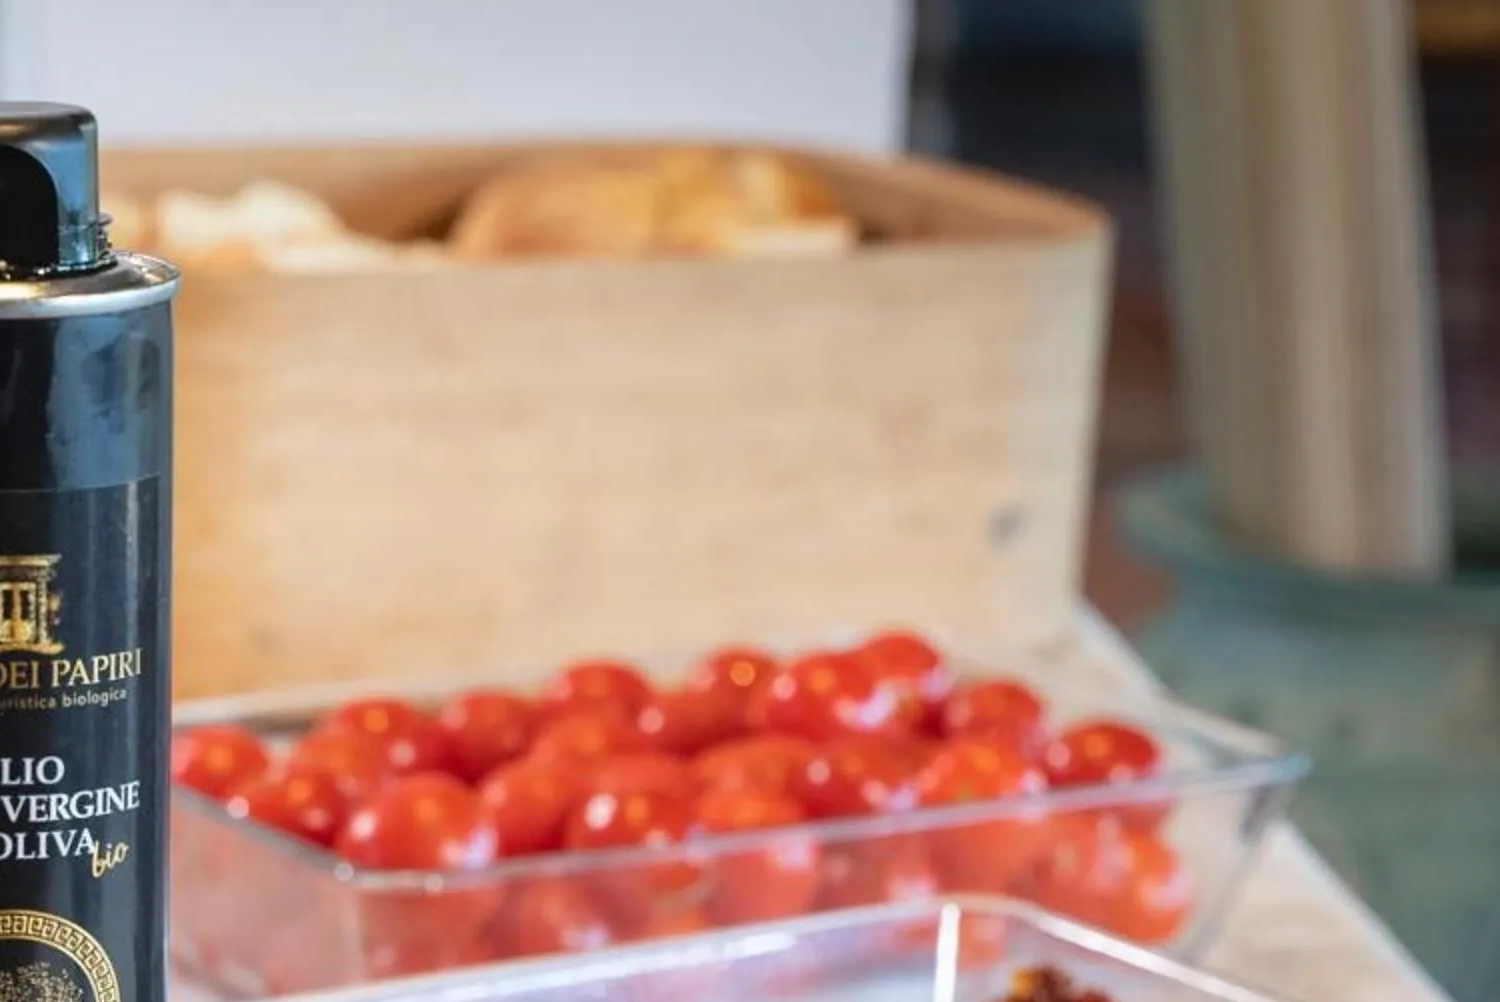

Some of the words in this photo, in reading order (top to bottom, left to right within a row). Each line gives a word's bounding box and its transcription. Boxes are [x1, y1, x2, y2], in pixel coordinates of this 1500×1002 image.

[52, 648, 143, 687] PAPIRI
[62, 687, 127, 708] biologica
[0, 781, 140, 822] VERGINE
[91, 840, 128, 878] bio
